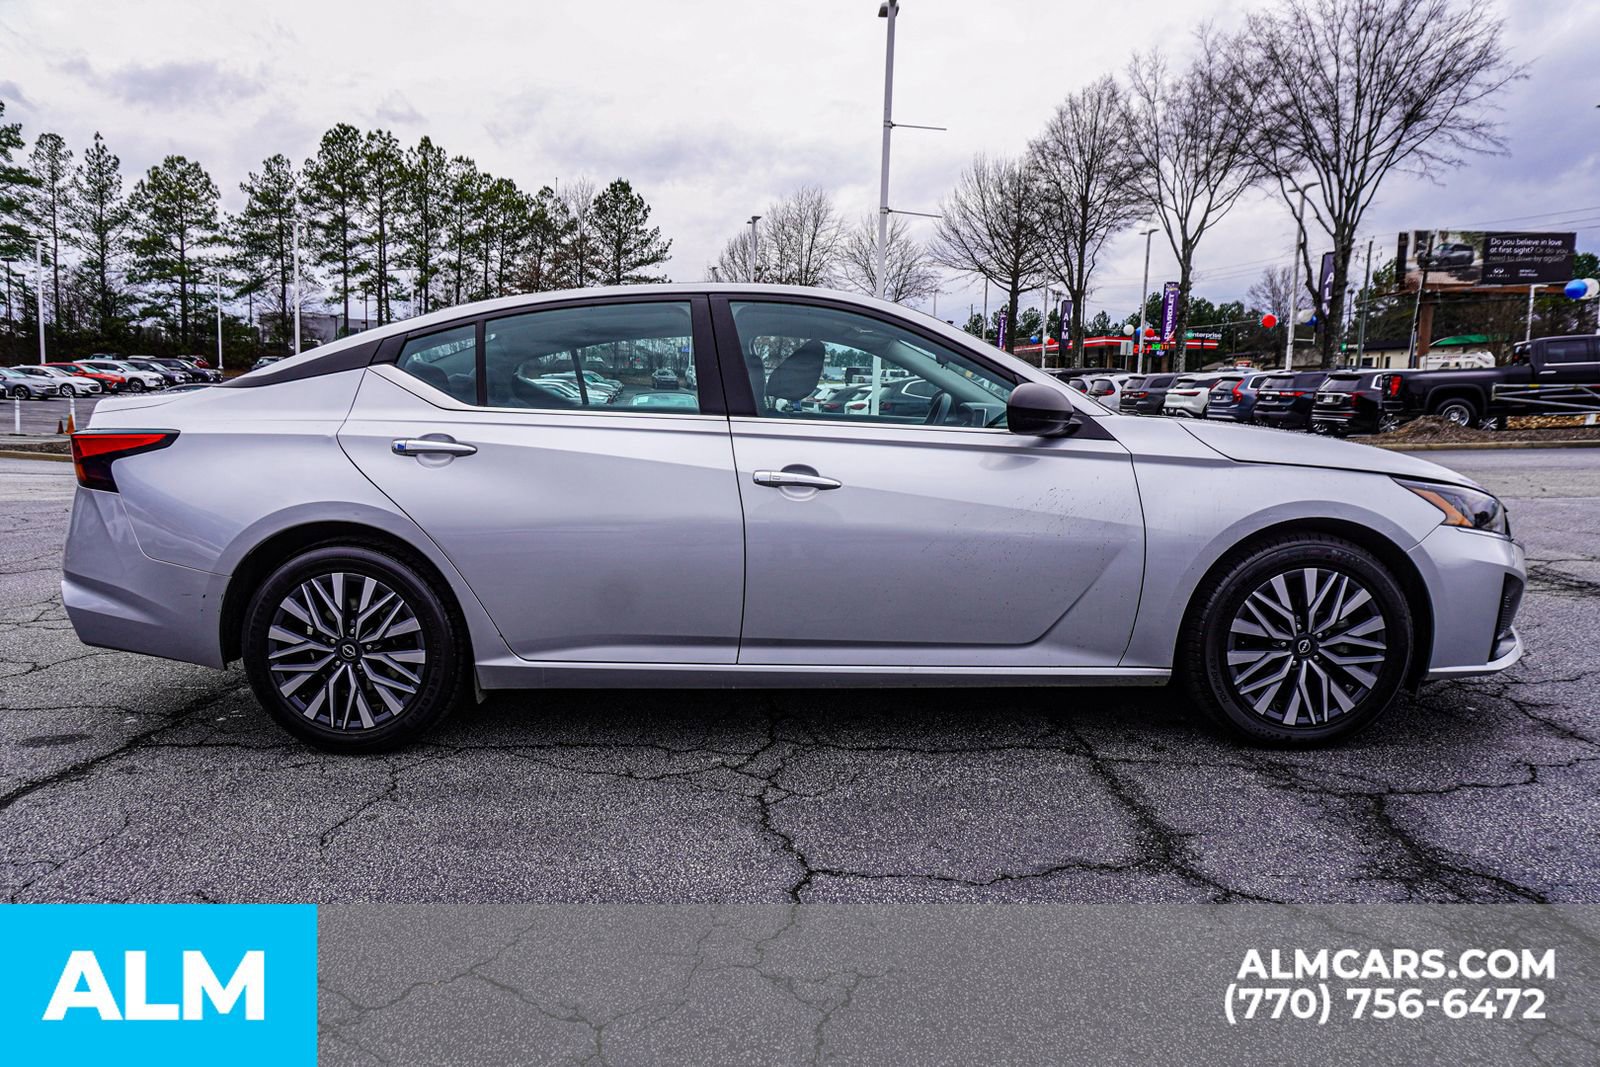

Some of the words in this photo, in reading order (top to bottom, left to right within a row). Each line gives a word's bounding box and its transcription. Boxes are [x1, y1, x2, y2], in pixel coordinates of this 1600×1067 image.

[1490, 238, 1501, 246] Do
[1502, 238, 1515, 246] you
[1516, 238, 1539, 246] believe
[1540, 238, 1548, 246] in
[1548, 238, 1563, 246] love
[1513, 246, 1535, 255] sight?
[1163, 292, 1175, 341] CHEVROLET
[1061, 312, 1070, 340] ALM
[1187, 331, 1223, 339] enterprise
